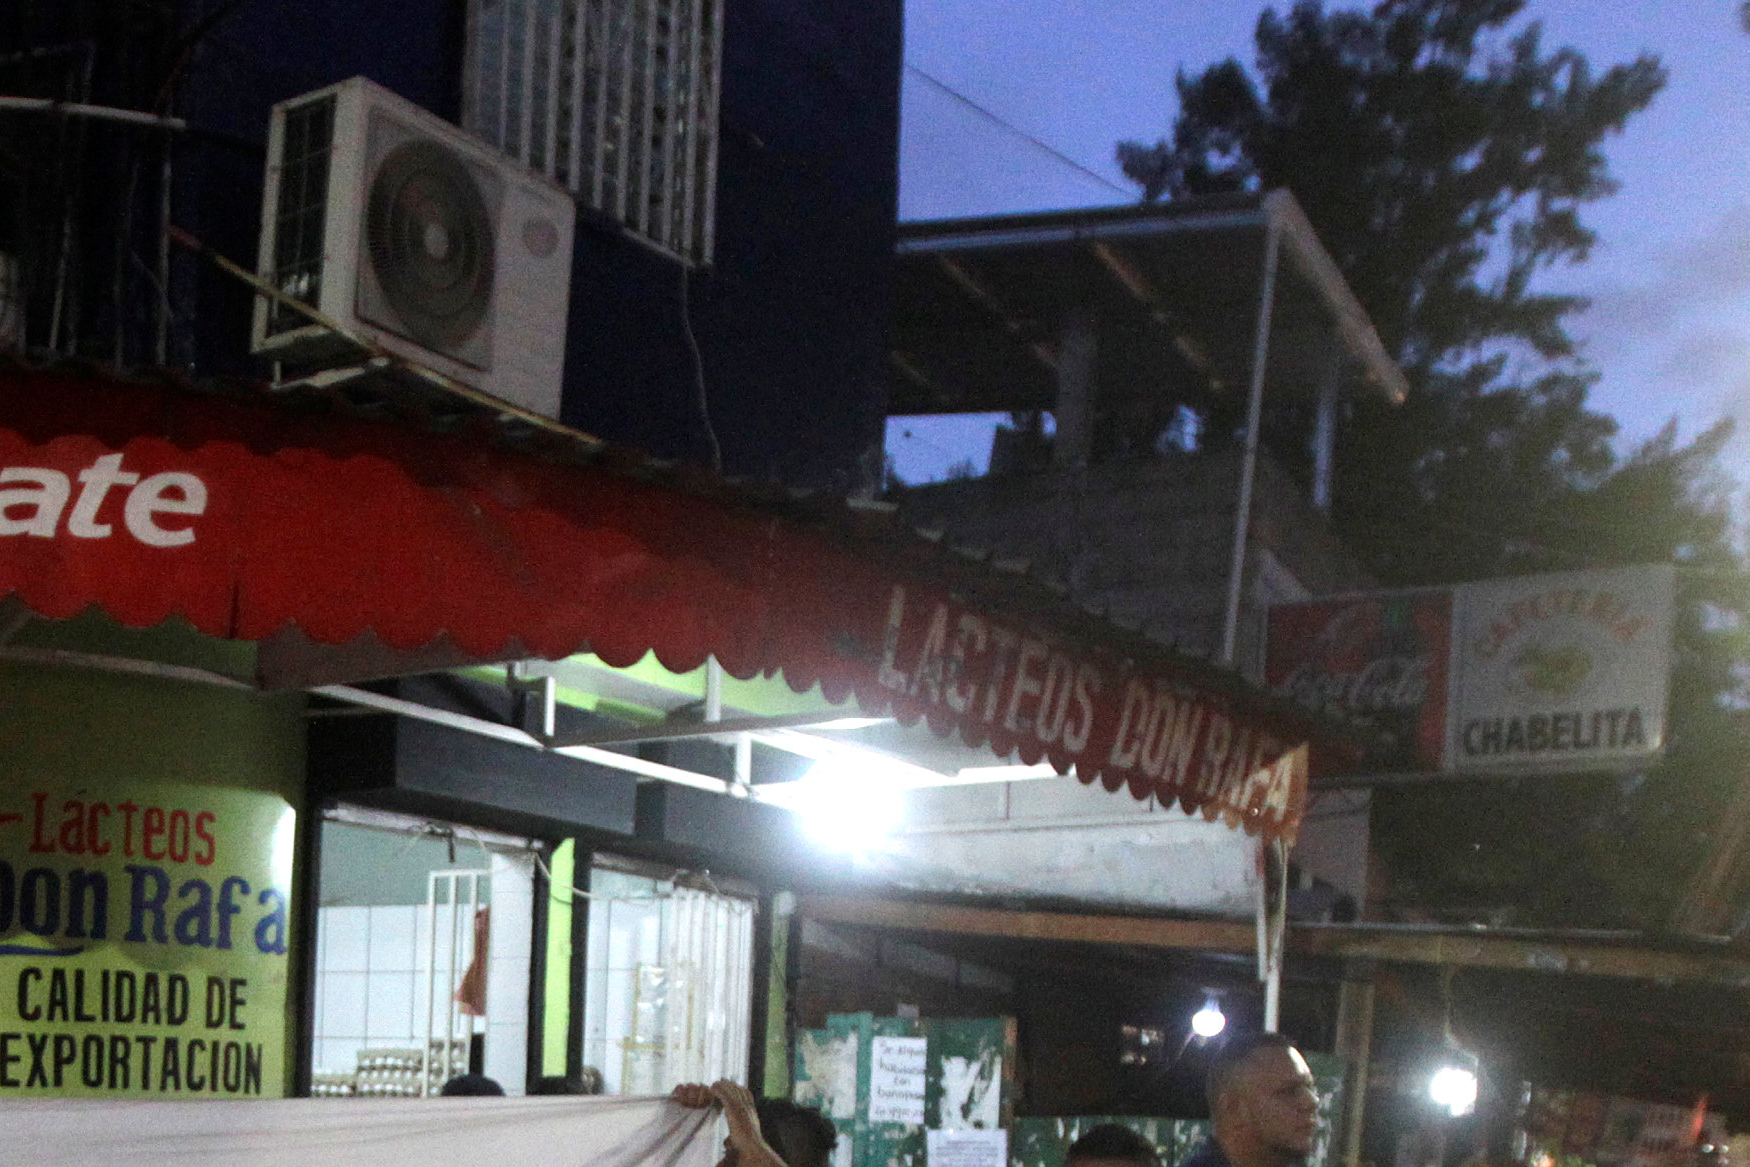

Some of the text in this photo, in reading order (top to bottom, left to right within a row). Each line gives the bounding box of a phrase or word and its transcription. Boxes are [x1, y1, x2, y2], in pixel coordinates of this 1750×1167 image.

[878, 583, 1102, 754] LACTEOS
[1464, 706, 1645, 755] CHABELITA
[124, 863, 288, 956] Rafa
[17, 965, 248, 1030] CALIDAD DE
